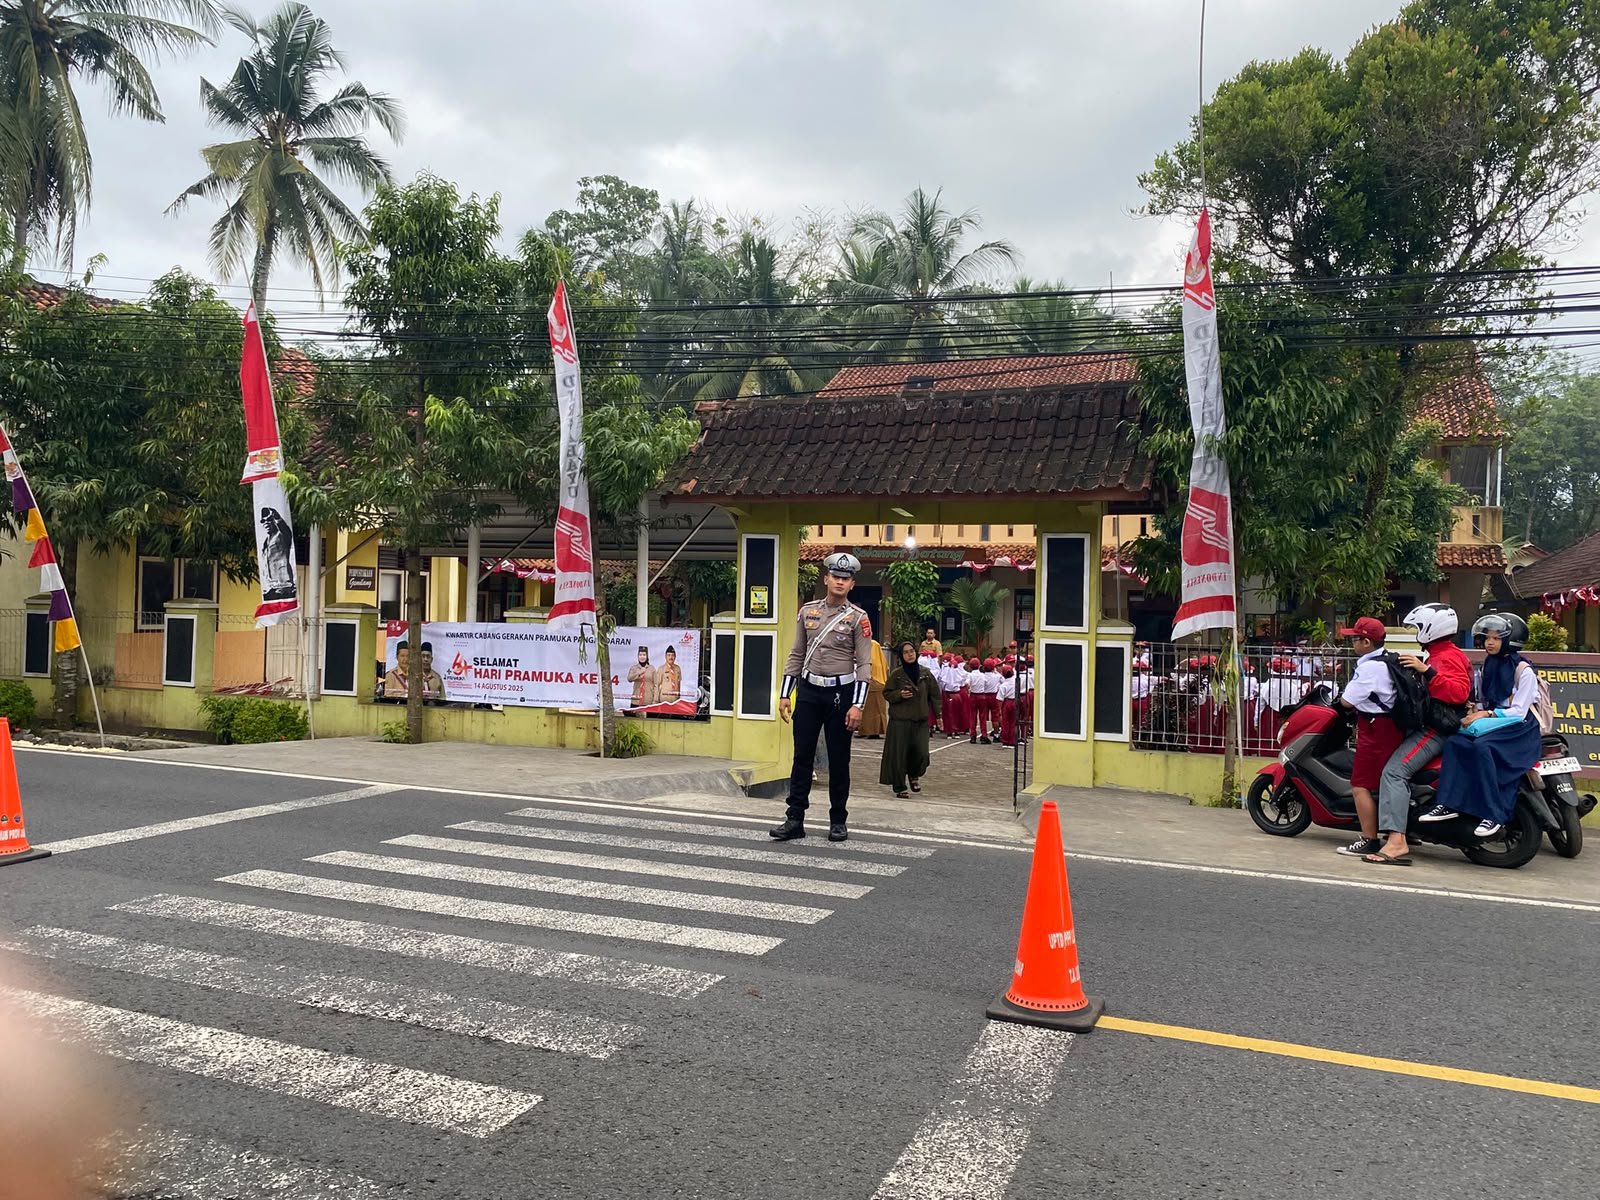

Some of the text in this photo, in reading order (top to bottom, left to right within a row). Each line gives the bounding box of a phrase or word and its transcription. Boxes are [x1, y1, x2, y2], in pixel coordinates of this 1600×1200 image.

[474, 632, 501, 640] CABANG
[502, 632, 534, 641] GERAKAN
[535, 634, 572, 643] PRAMUKA
[473, 656, 519, 668] SELAMAT
[474, 668, 501, 680] HARI
[505, 669, 575, 684] PRAMUKA
[481, 683, 507, 691] AGUSTUS
[508, 684, 524, 692] 2025
